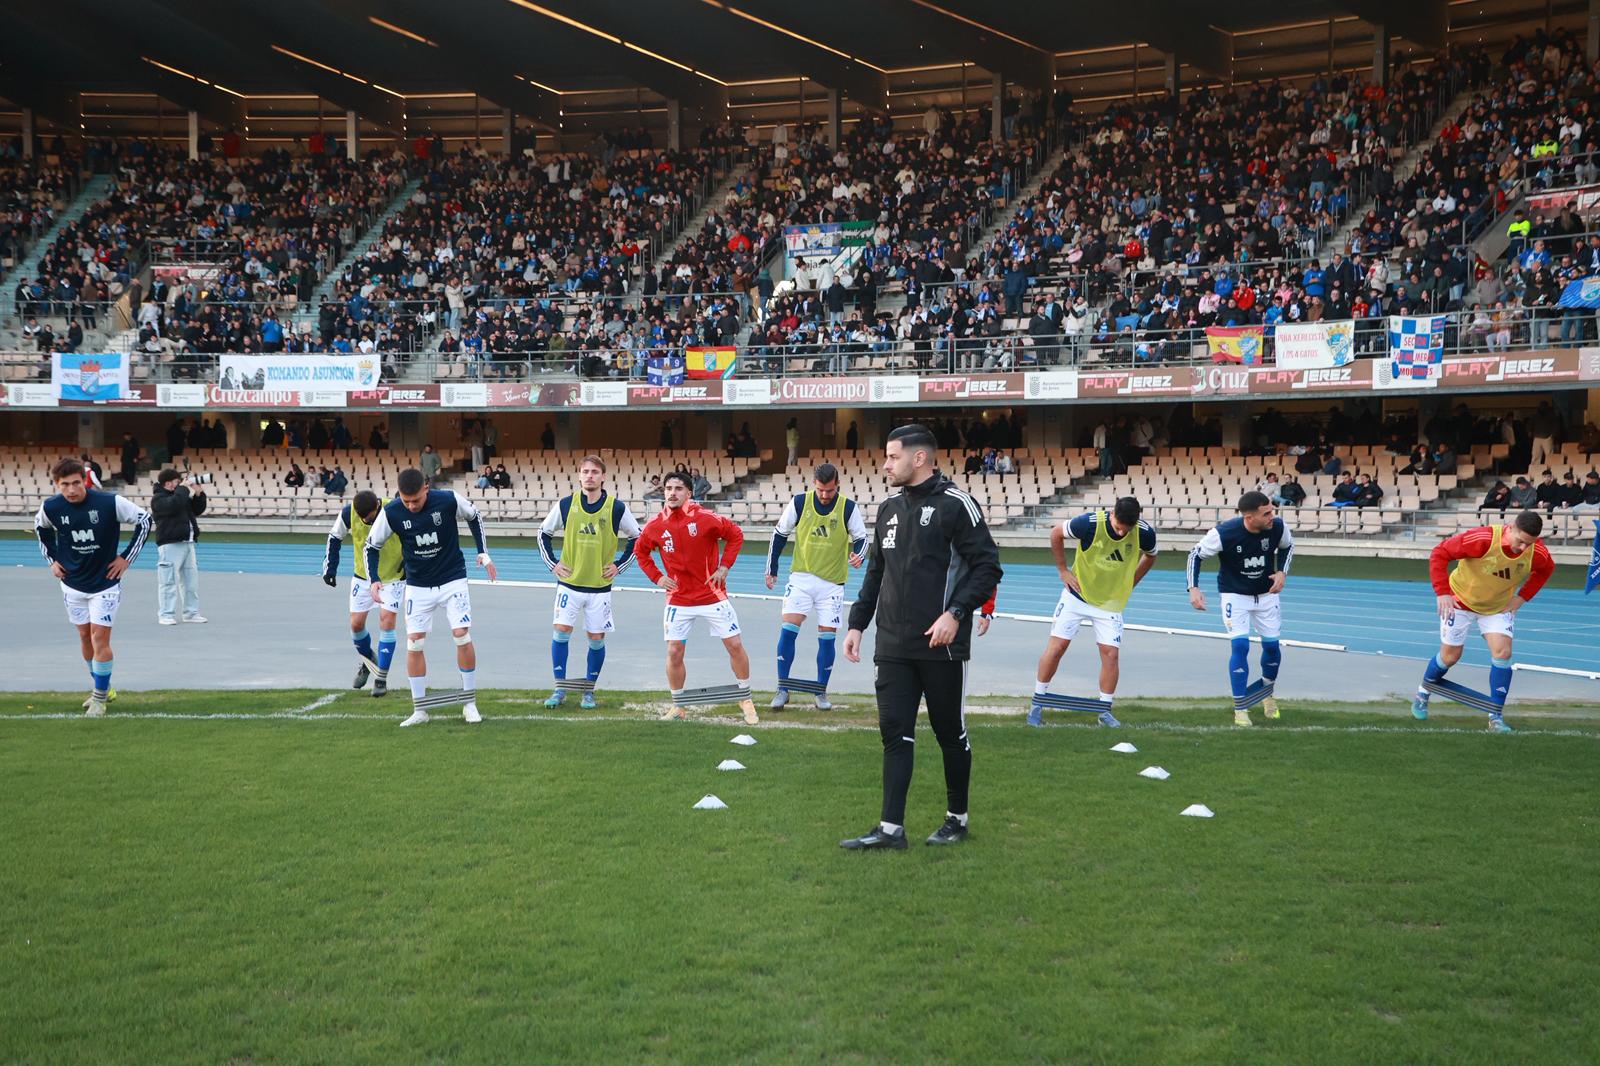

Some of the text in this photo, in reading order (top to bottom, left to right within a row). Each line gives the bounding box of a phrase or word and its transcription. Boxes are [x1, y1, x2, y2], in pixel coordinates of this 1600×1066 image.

[674, 359, 680, 367] 9
[1445, 361, 1495, 377] PLAY
[1485, 358, 1555, 381] JEREZ
[652, 376, 680, 384] 4 7
[1084, 377, 1124, 389] PLAY
[1117, 375, 1173, 394] JEREZ
[1208, 366, 1249, 390] Cruz
[1255, 368, 1352, 389] PLAY JEREZ
[352, 390, 386, 399] PLAY
[380, 389, 426, 404] JEREZ
[632, 387, 667, 398] PLAY
[661, 386, 707, 403] JEREZ
[782, 380, 866, 401] Cruzcampo
[925, 381, 962, 392] PLAY
[955, 380, 1007, 398] JEREZ
[61, 515, 70, 525] 14
[402, 519, 412, 530] 10
[1236, 545, 1242, 553] 9
[557, 593, 569, 609] 18
[666, 606, 678, 623] 11
[1225, 602, 1233, 618] 9
